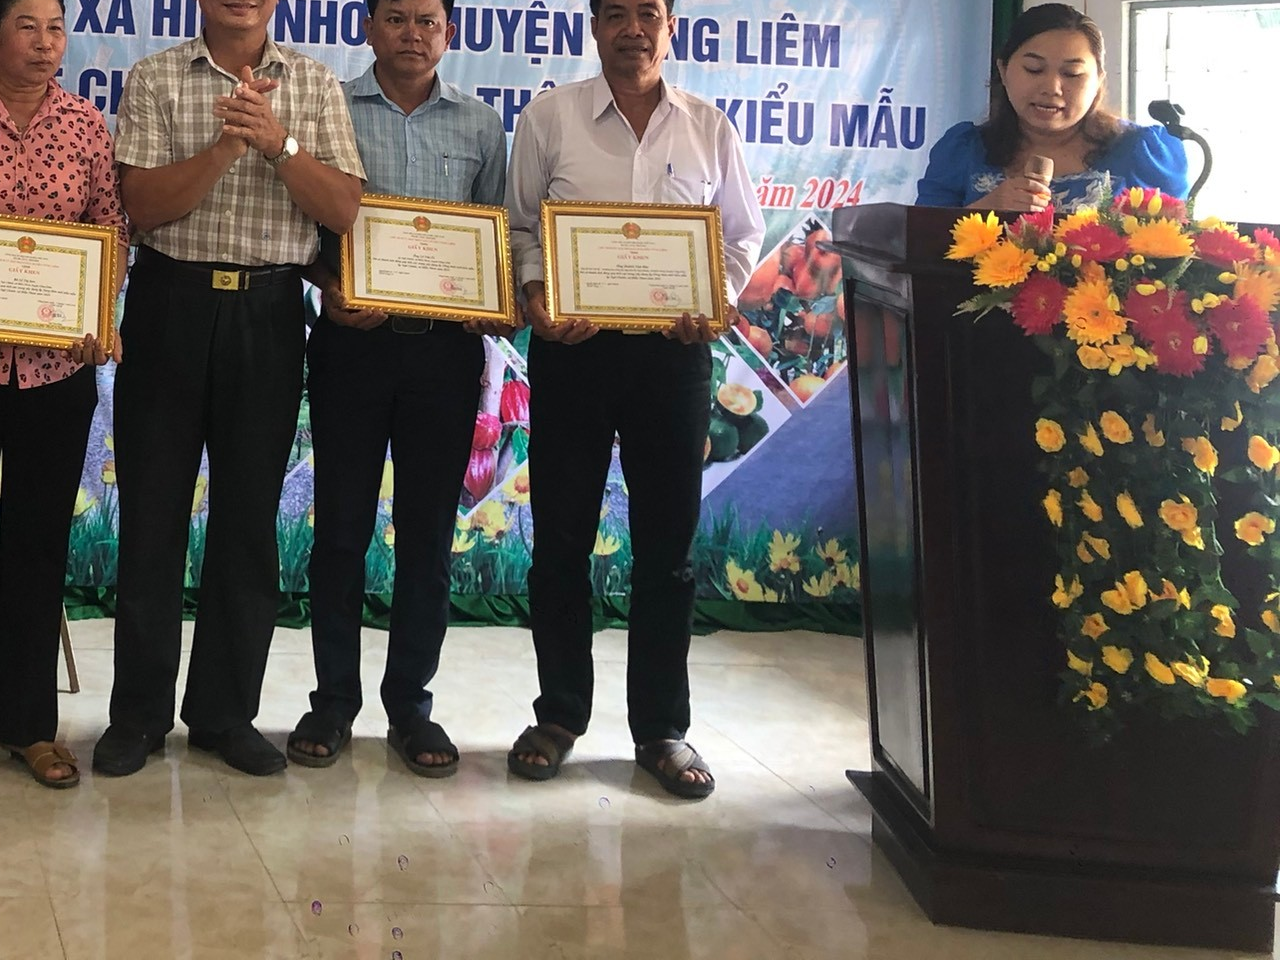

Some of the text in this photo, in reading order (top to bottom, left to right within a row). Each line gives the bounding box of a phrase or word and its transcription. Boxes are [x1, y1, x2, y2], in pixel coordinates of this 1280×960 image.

[736, 13, 841, 68] LIÊM
[716, 83, 815, 147] KIỂU
[830, 86, 926, 149] MẪU
[757, 177, 863, 208] ăm 2024
